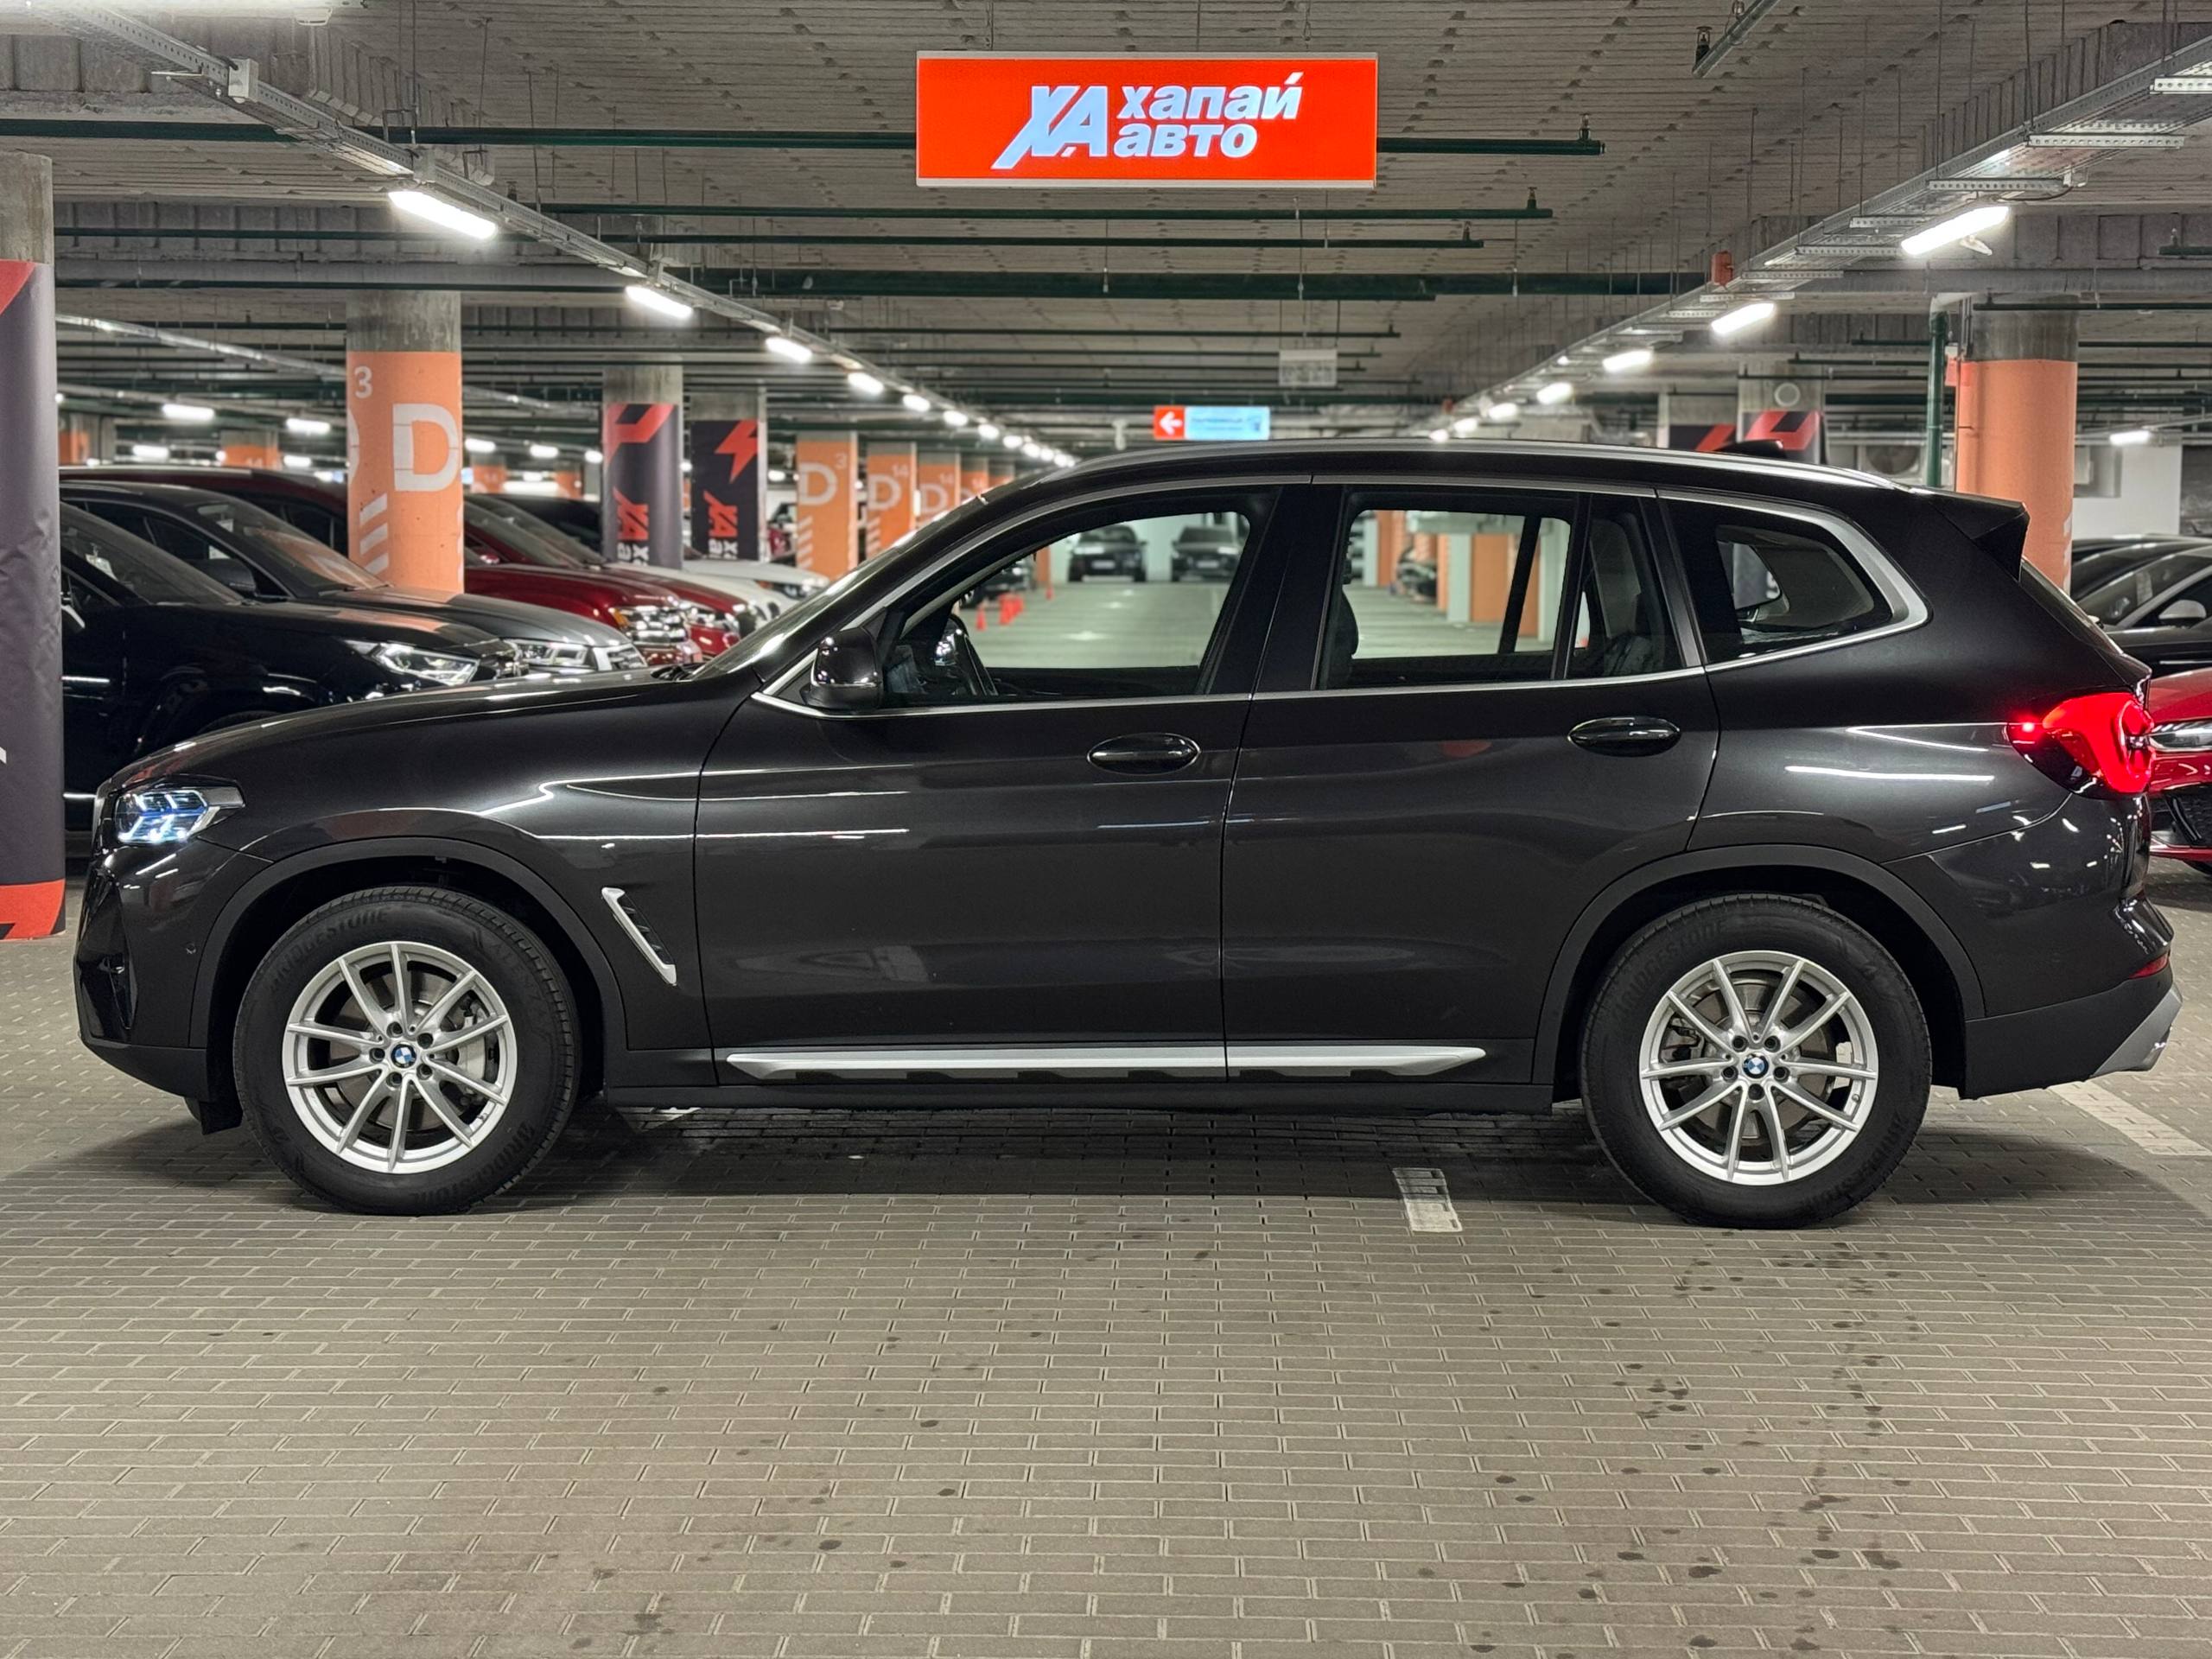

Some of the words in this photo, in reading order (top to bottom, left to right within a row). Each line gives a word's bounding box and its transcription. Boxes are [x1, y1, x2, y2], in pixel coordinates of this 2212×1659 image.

[1116, 72, 1304, 120] хапай
[1113, 122, 1259, 158] авто
[354, 365, 373, 399] 3
[392, 403, 459, 493] D
[798, 462, 838, 505] D
[833, 453, 848, 469] 3
[868, 474, 901, 510] D
[919, 482, 949, 513] D
